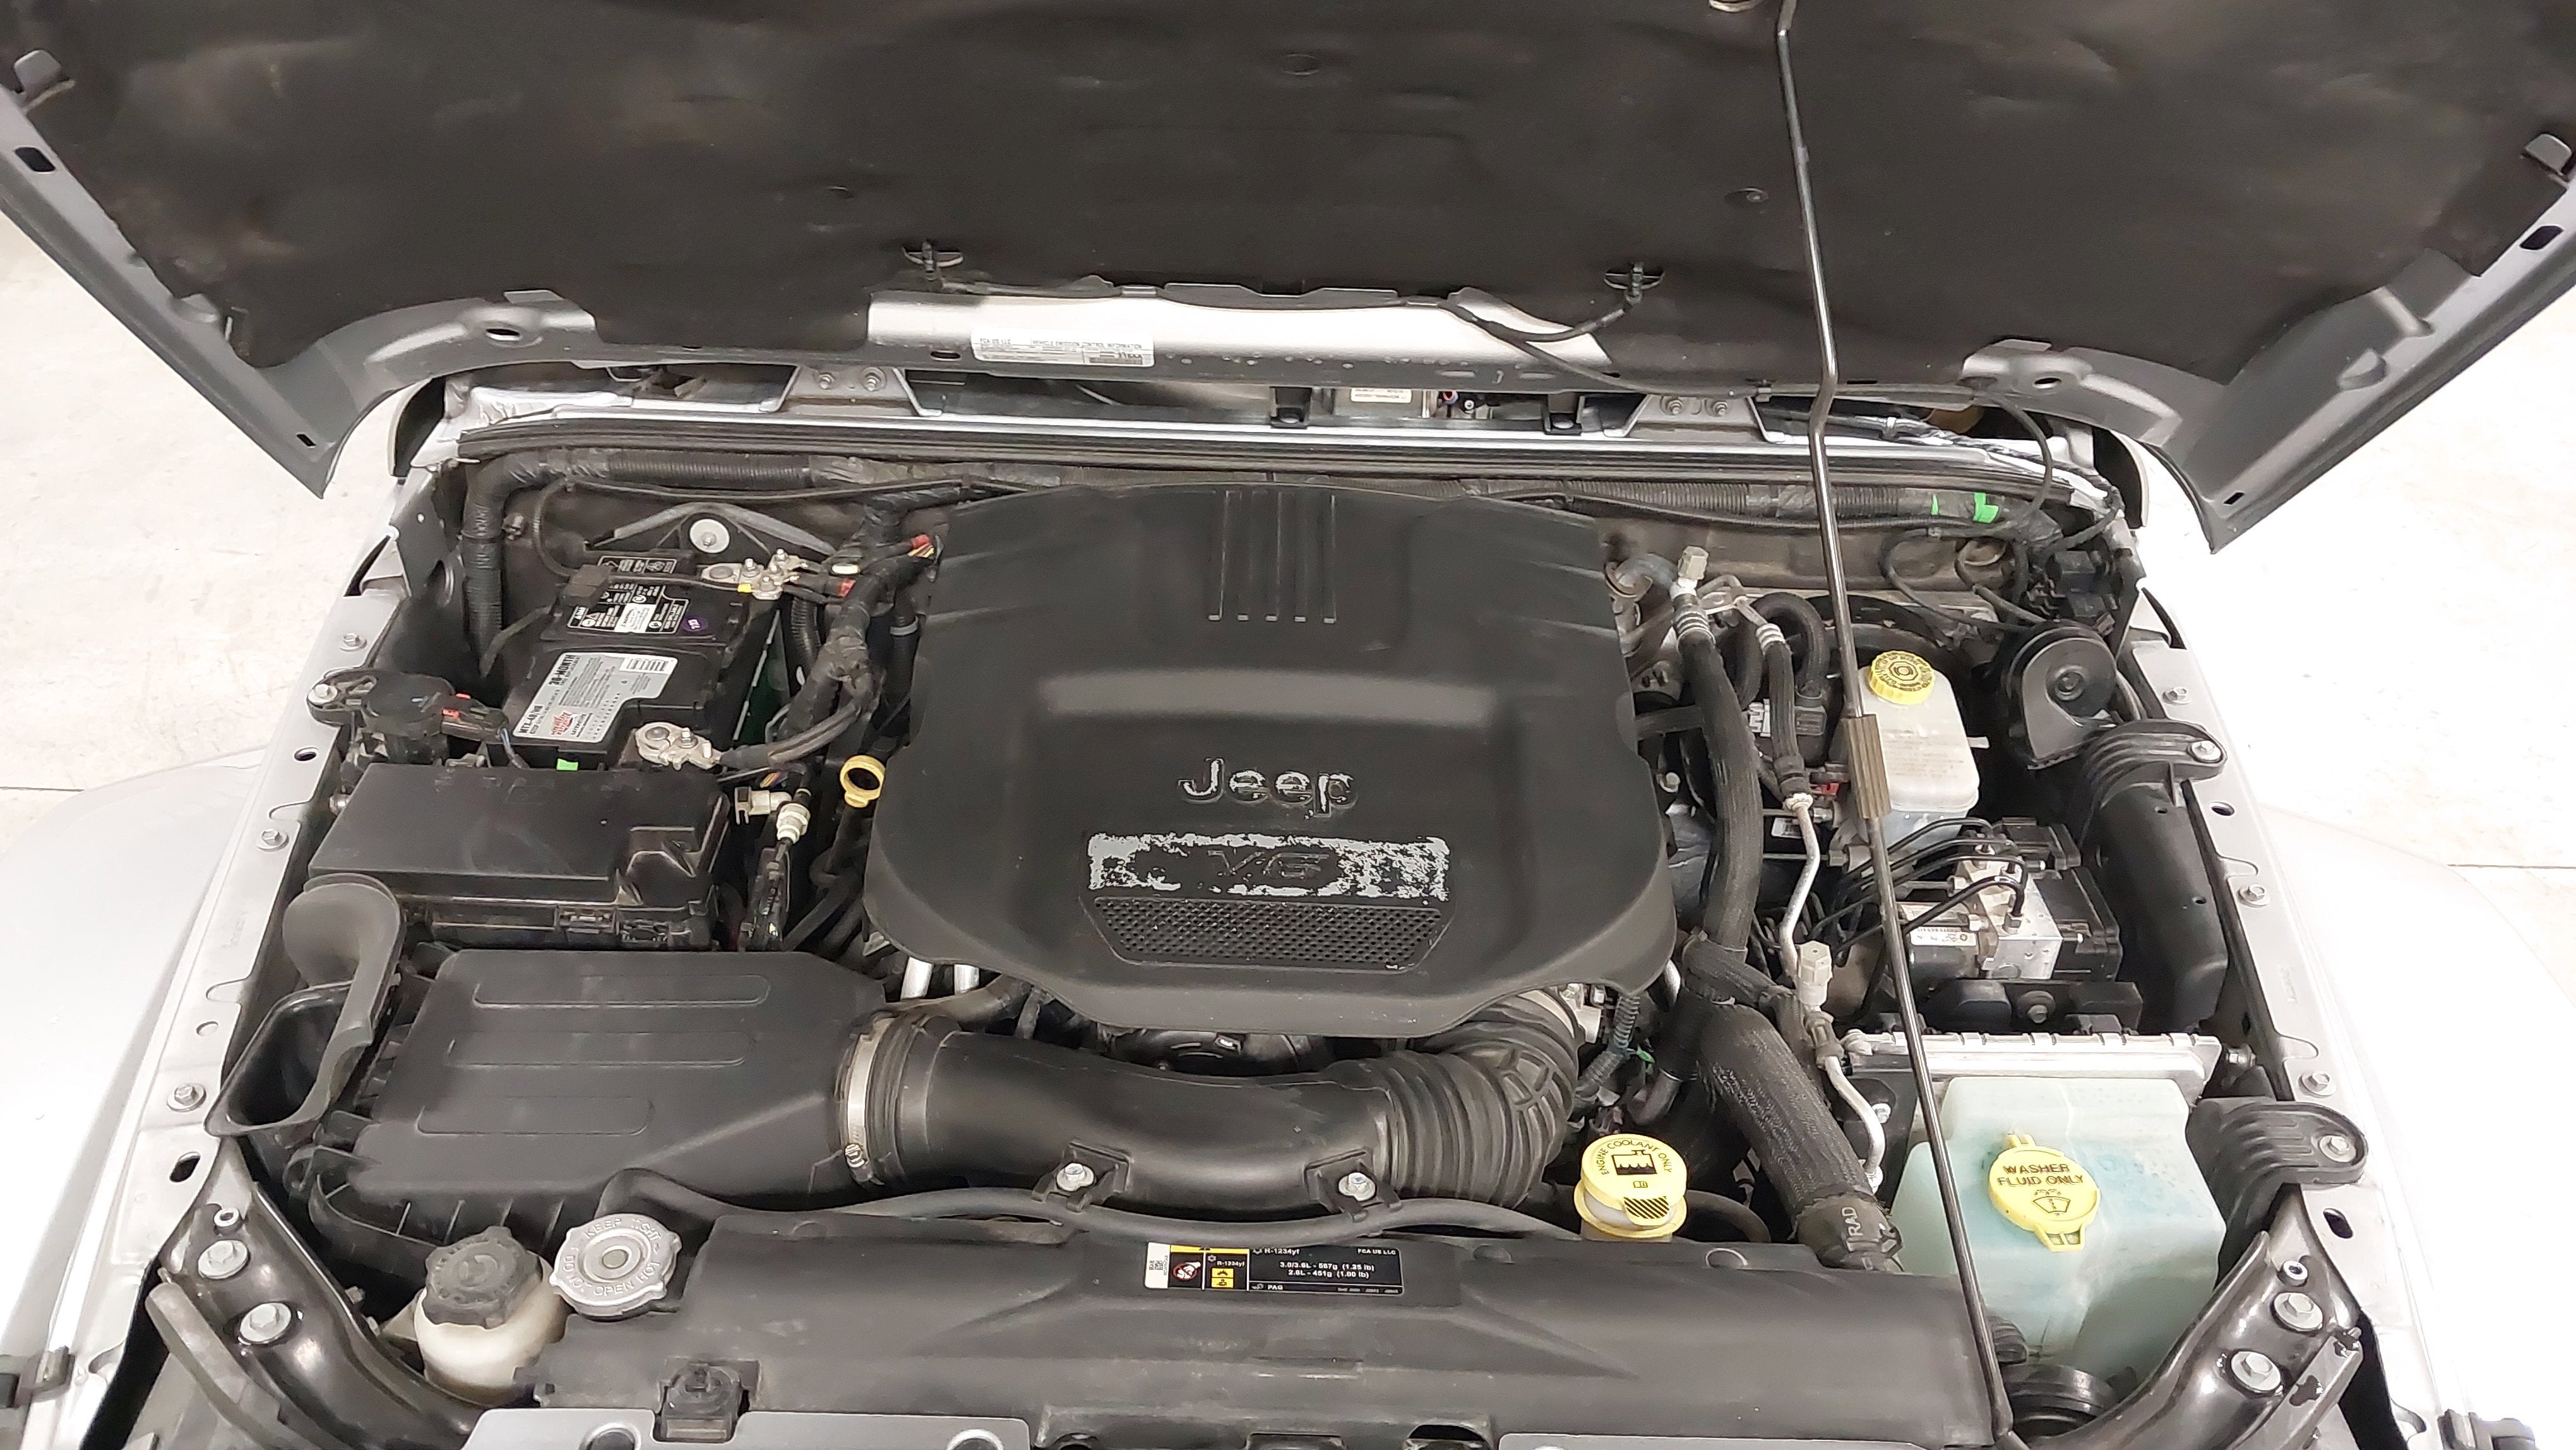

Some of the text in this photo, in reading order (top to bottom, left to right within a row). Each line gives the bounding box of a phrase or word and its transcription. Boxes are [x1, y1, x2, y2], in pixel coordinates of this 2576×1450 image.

[1178, 757, 1358, 819] Jeep
[1207, 849, 1330, 880] V6
[1596, 1139, 1673, 1175] ENGINE COOLANT ONLY
[2003, 1163, 2070, 1174] WASHER
[1997, 1175, 2084, 1187] FLUID ONLY
[583, 1218, 622, 1239] KEEP
[1841, 1207, 1864, 1237] RAD
[1264, 1248, 1300, 1256] R-1234yf
[593, 1281, 635, 1297] OPEN
